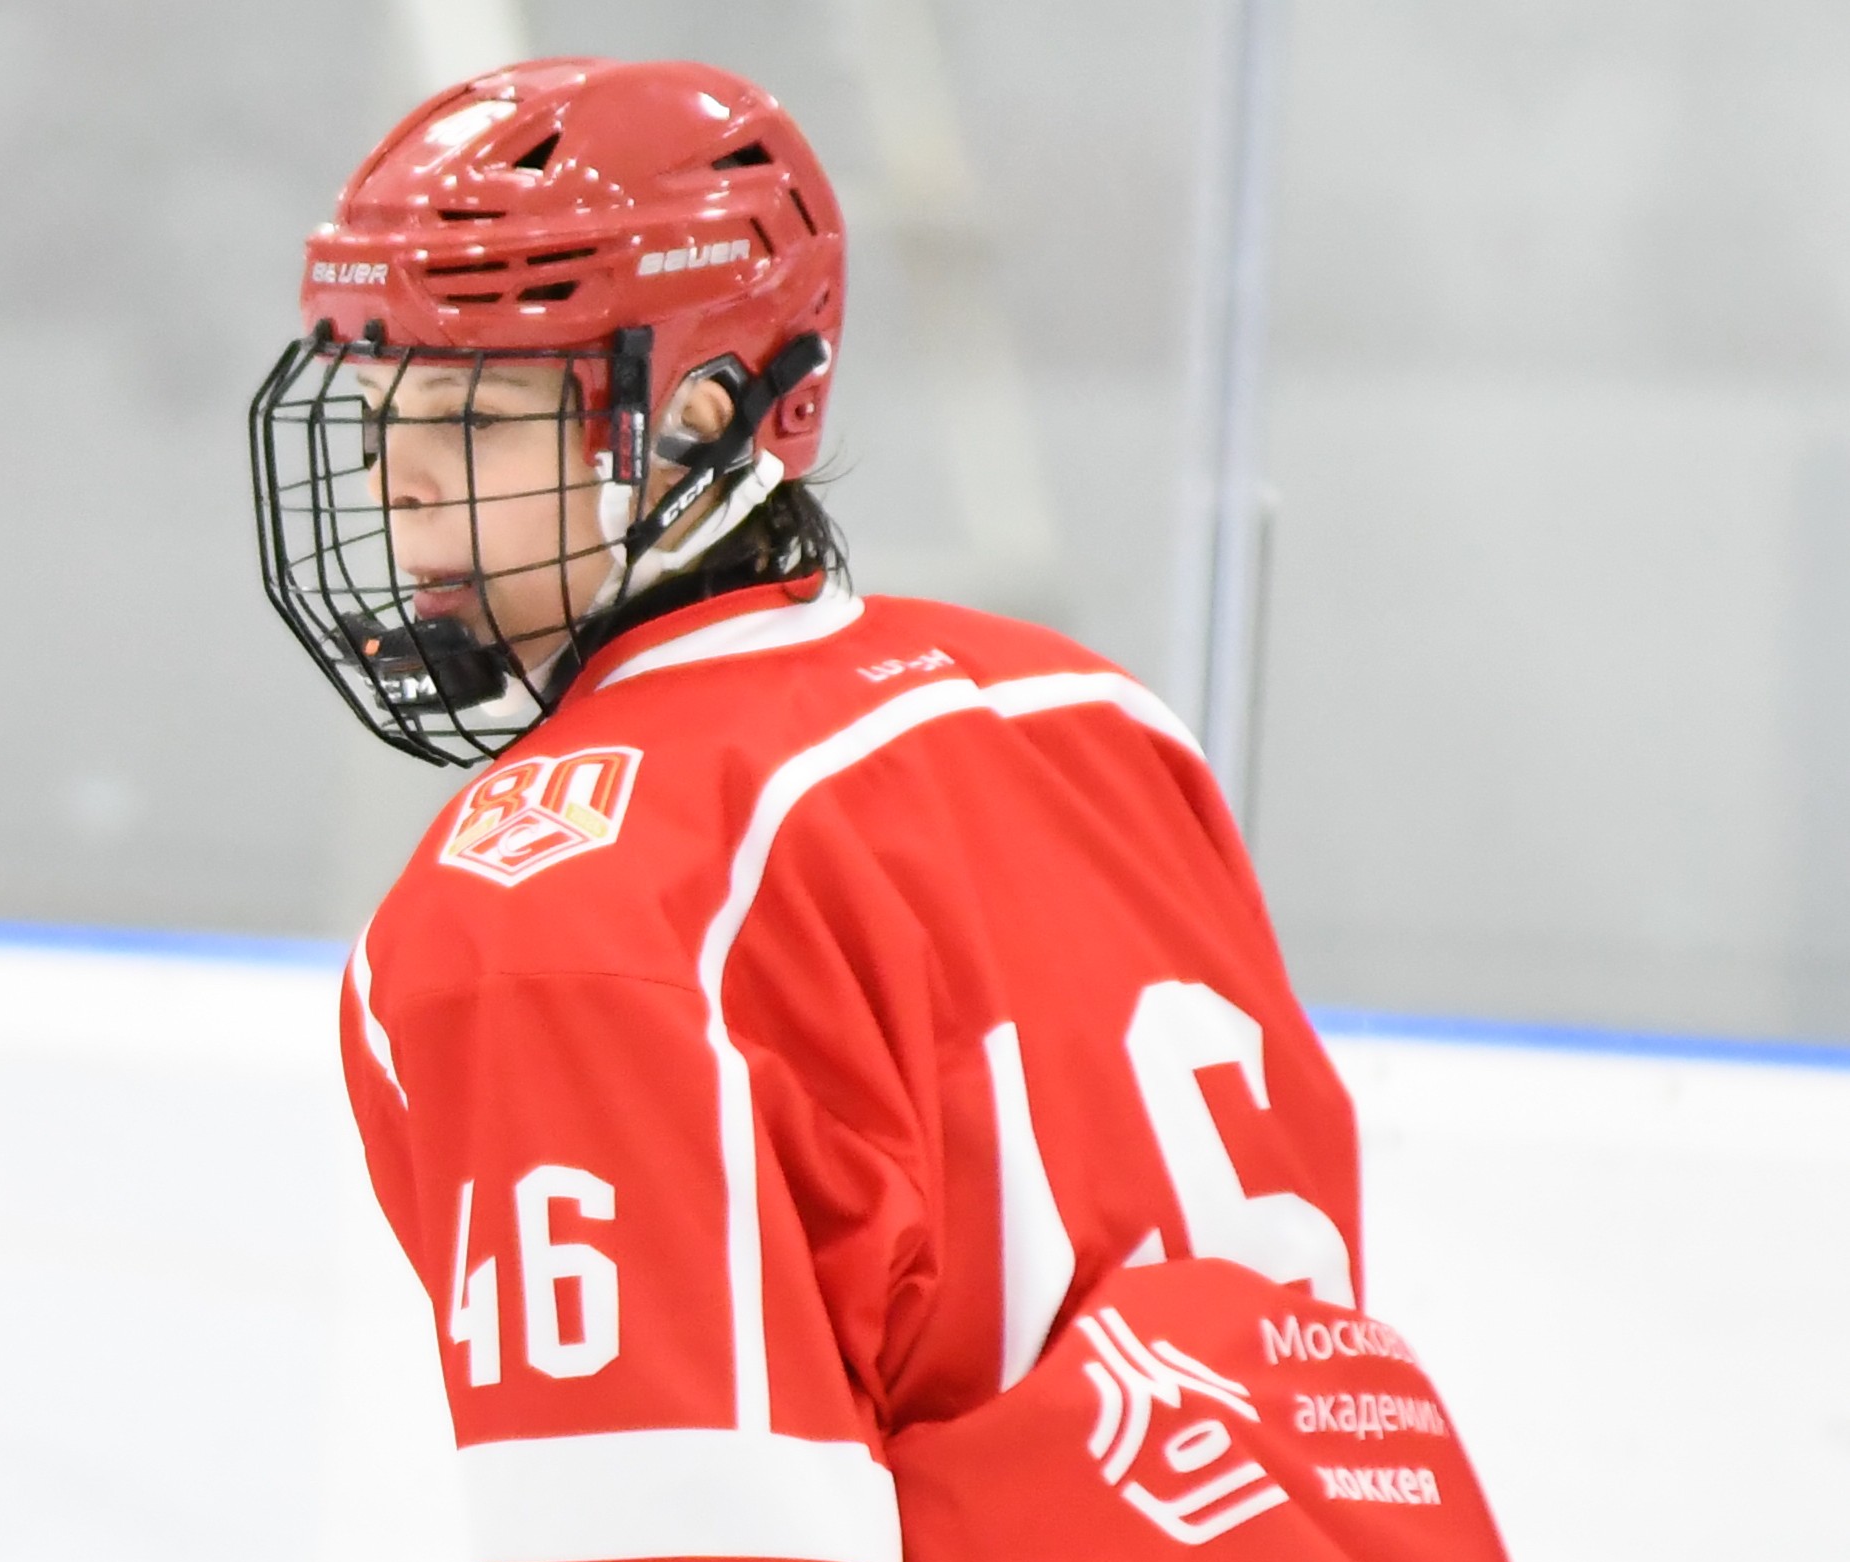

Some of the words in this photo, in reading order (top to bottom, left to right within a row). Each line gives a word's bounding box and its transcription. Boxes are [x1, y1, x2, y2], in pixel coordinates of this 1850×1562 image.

[312, 262, 389, 285] BAUER
[636, 239, 750, 276] BAUER
[449, 1164, 621, 1389] 46
[1313, 1466, 1442, 1506] хоккея
